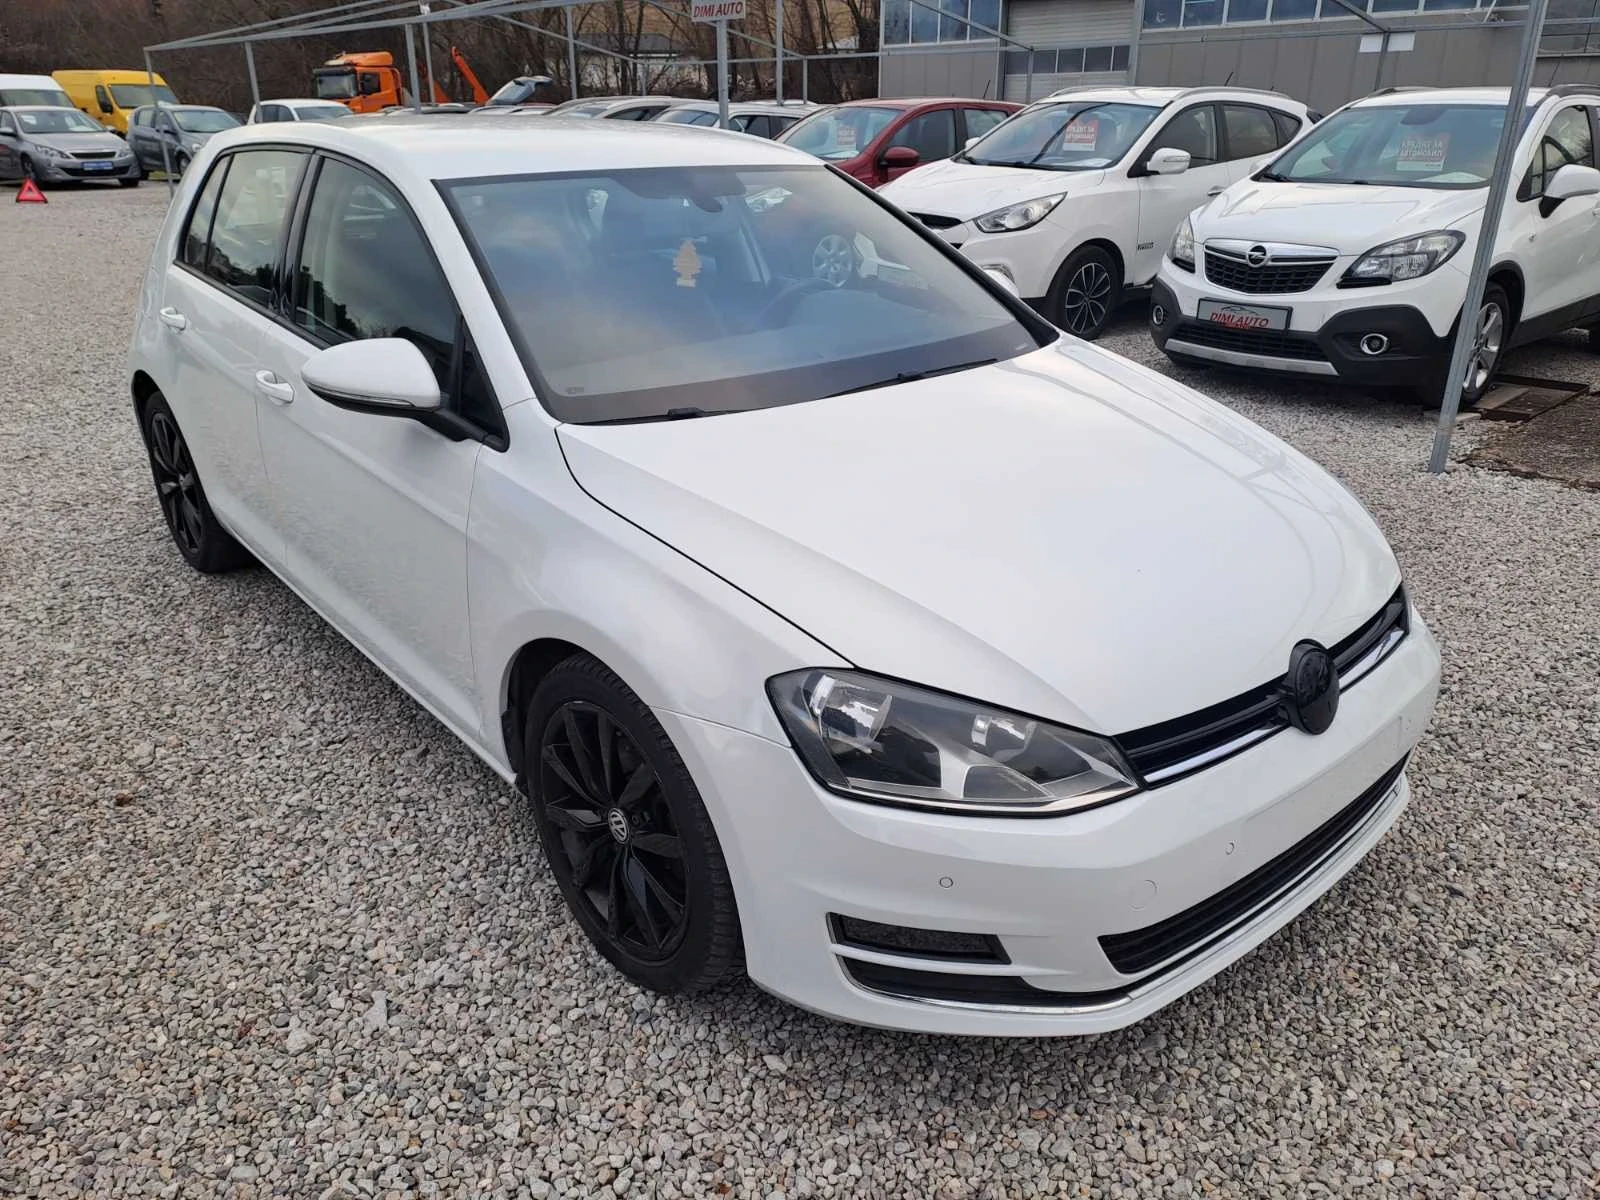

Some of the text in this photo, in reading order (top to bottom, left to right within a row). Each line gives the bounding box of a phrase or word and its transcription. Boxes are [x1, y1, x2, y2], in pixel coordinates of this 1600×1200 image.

[694, 2, 743, 17] DIMI AUTO
[1210, 312, 1235, 323] DIMI
[1235, 315, 1269, 328] AUTO
